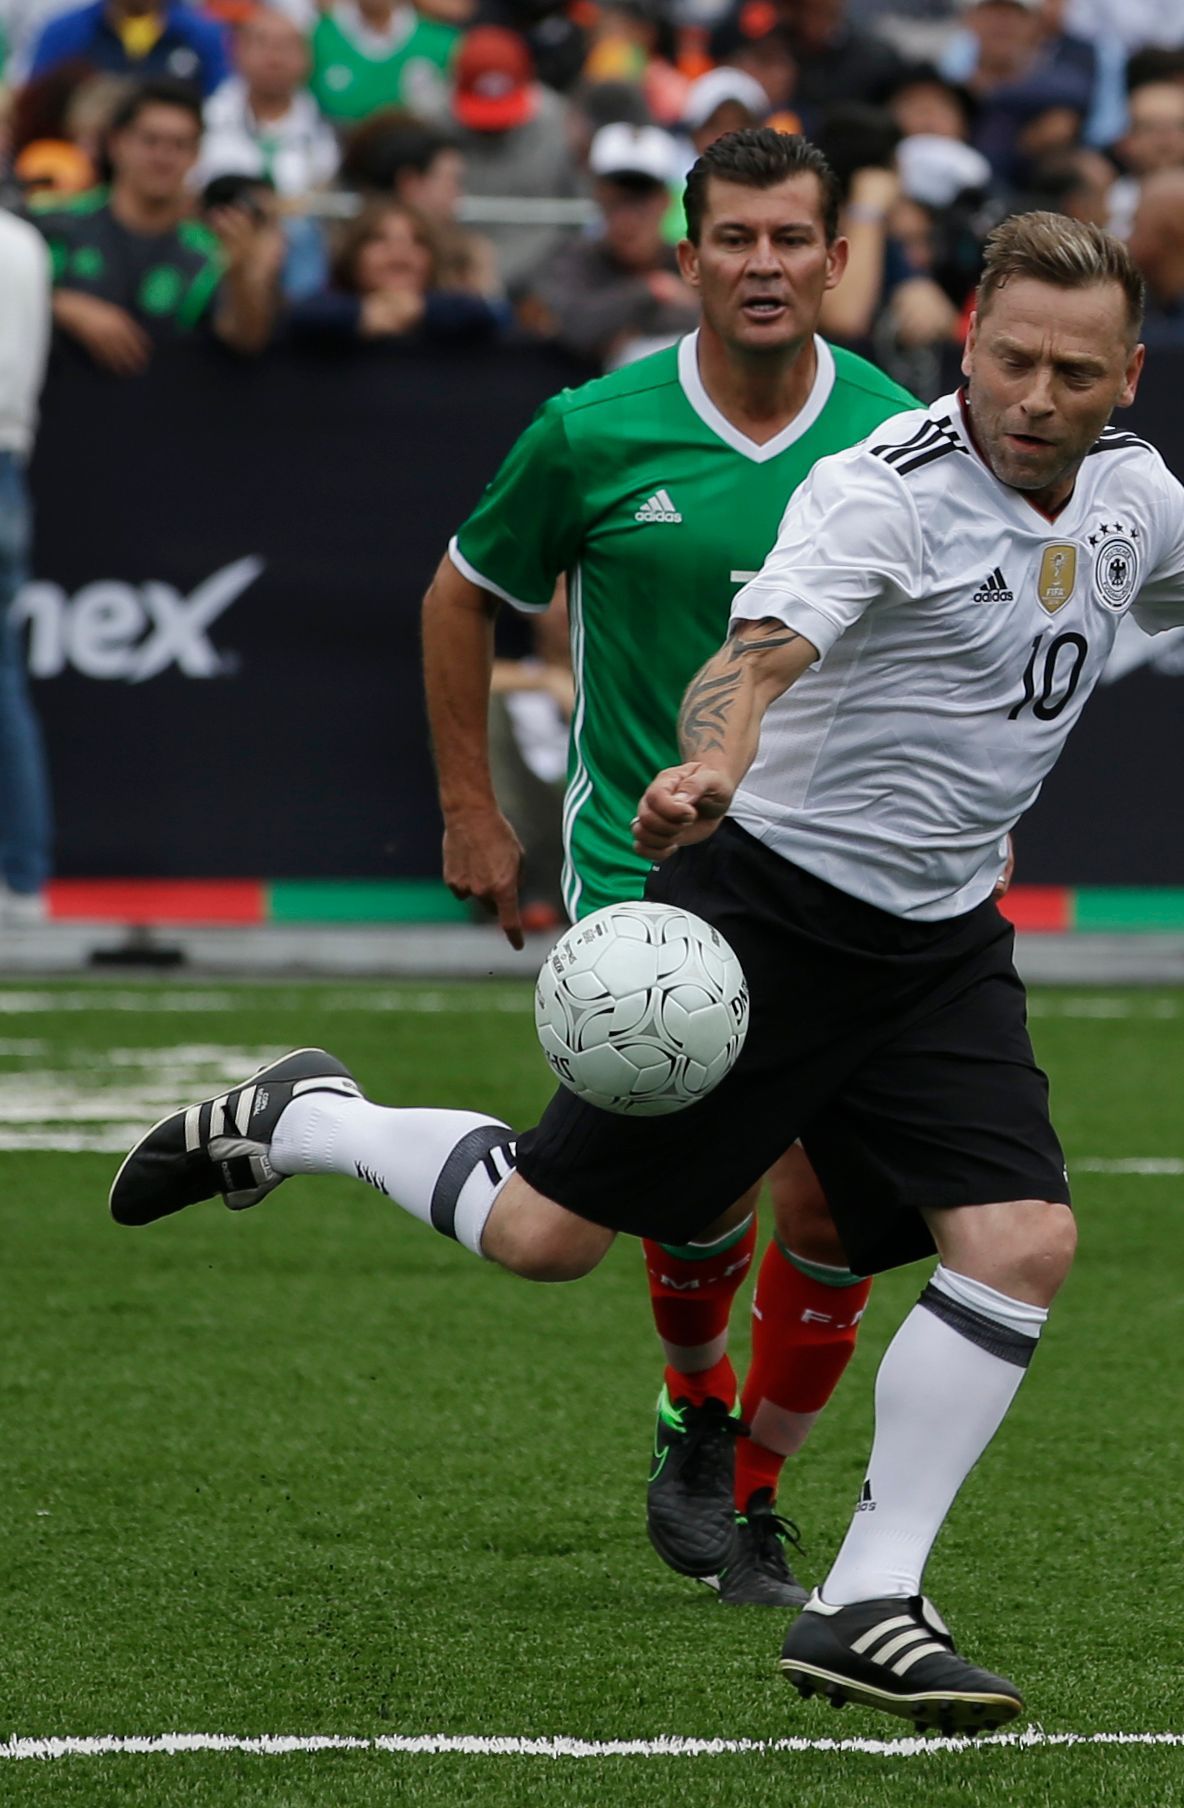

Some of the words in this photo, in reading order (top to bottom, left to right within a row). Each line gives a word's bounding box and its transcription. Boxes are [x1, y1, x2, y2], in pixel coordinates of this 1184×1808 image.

[635, 511, 682, 523] adidas
[973, 589, 1014, 603] adidas
[1007, 632, 1089, 721] 10
